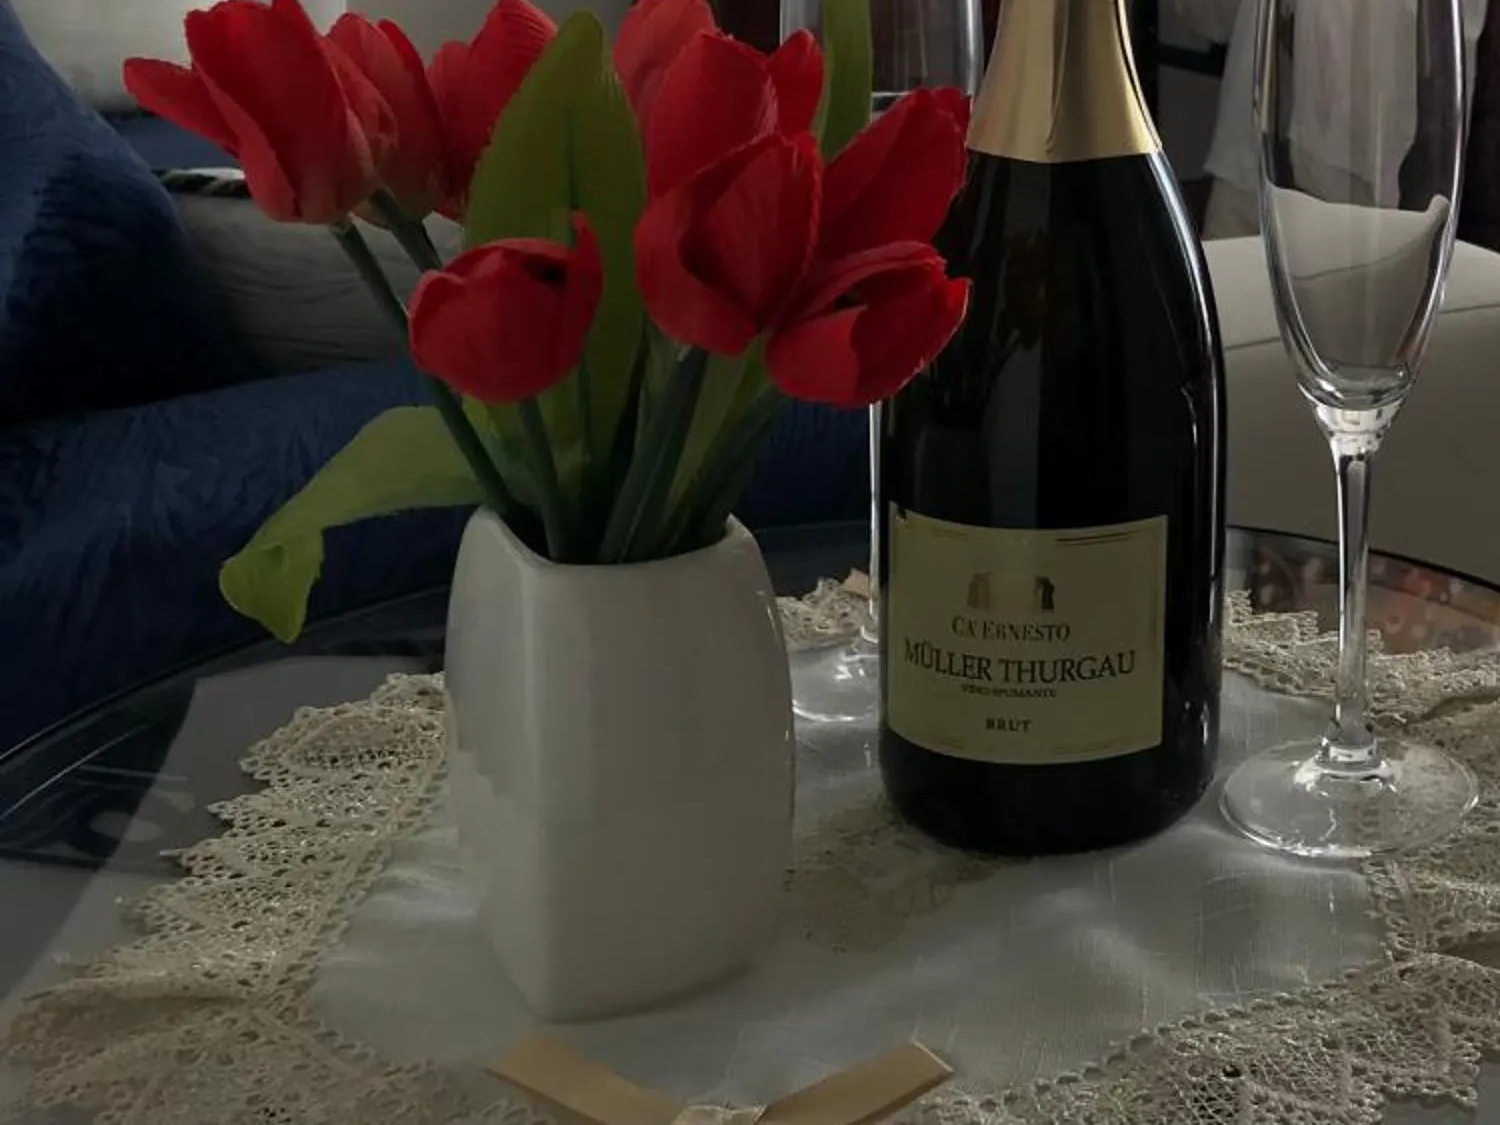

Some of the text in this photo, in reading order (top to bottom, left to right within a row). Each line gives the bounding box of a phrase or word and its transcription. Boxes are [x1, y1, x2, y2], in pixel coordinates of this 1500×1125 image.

[982, 619, 1071, 642] ERNESTO
[904, 637, 1137, 684] MÜLLER THURGAU
[985, 718, 1033, 733] BRUT
